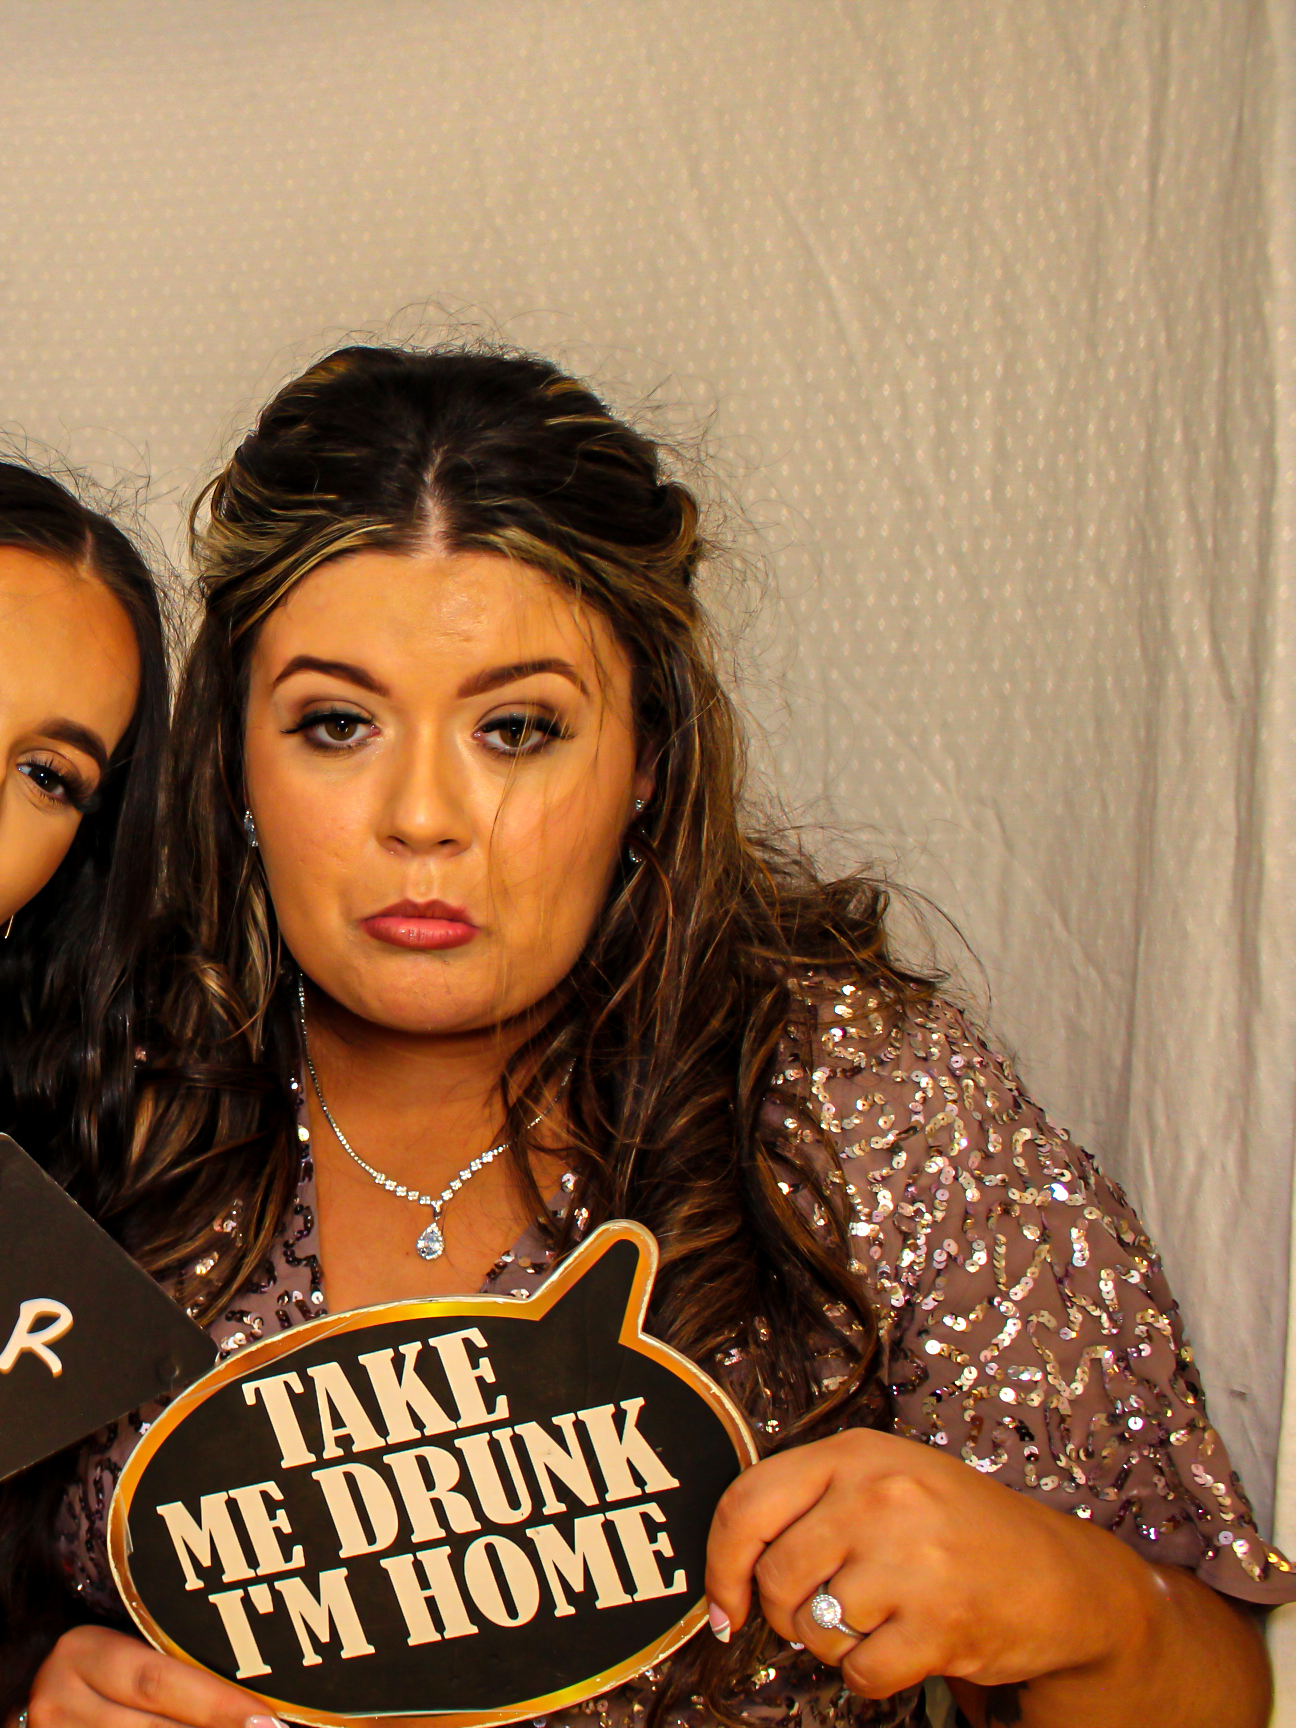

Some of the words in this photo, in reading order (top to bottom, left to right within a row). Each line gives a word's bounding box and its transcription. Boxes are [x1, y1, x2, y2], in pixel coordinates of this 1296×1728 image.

[241, 1327, 510, 1469] TAKE
[156, 1481, 306, 1592] ME
[311, 1397, 681, 1559] DRUNK
[208, 1567, 376, 1680] I'M
[379, 1502, 689, 1647] HOME
